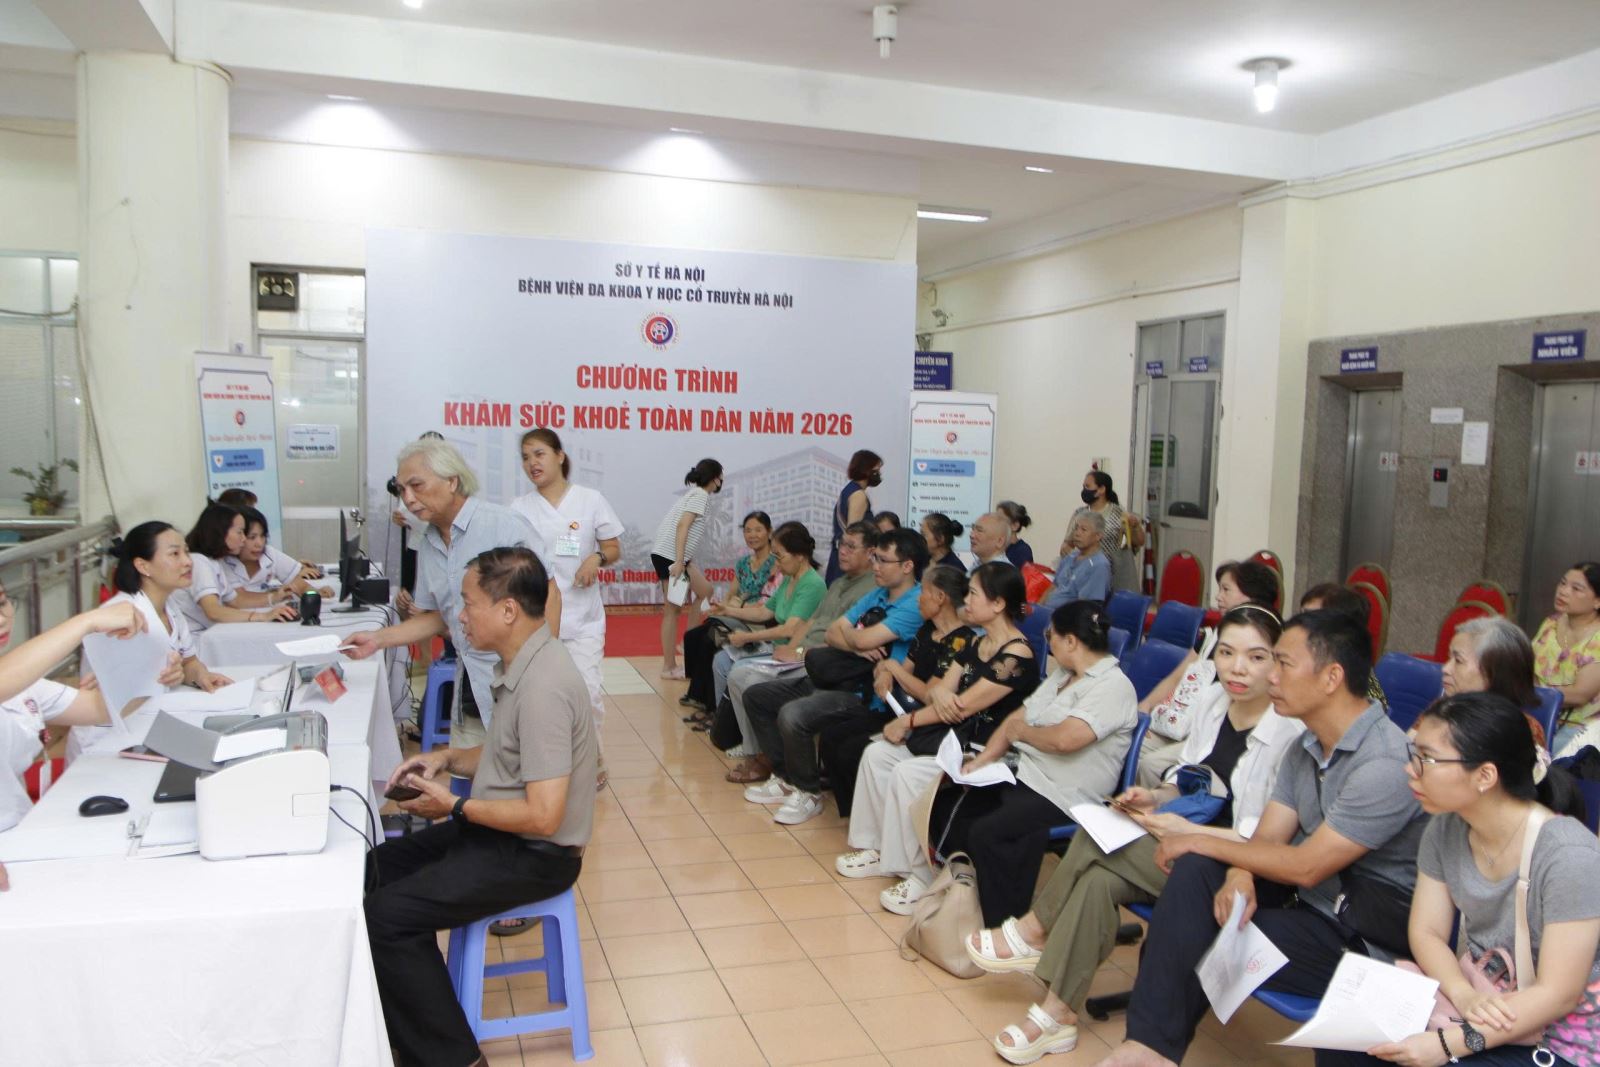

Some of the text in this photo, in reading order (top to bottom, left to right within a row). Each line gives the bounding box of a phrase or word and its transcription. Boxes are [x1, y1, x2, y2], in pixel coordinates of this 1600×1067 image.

[615, 260, 705, 283] SỞ Y TẾ HÀ NỘI
[518, 277, 793, 309] BỆNH VIỆN ĐA KHOA Y HỌC CỔ TRUYỀN HÀ NỘI
[576, 363, 738, 393] CHƯƠNG TRÌNH
[444, 399, 853, 436] KHÁM SỨC KHOẺ TOÀN DÂN NĂM 2026
[704, 567, 736, 582] 2026
